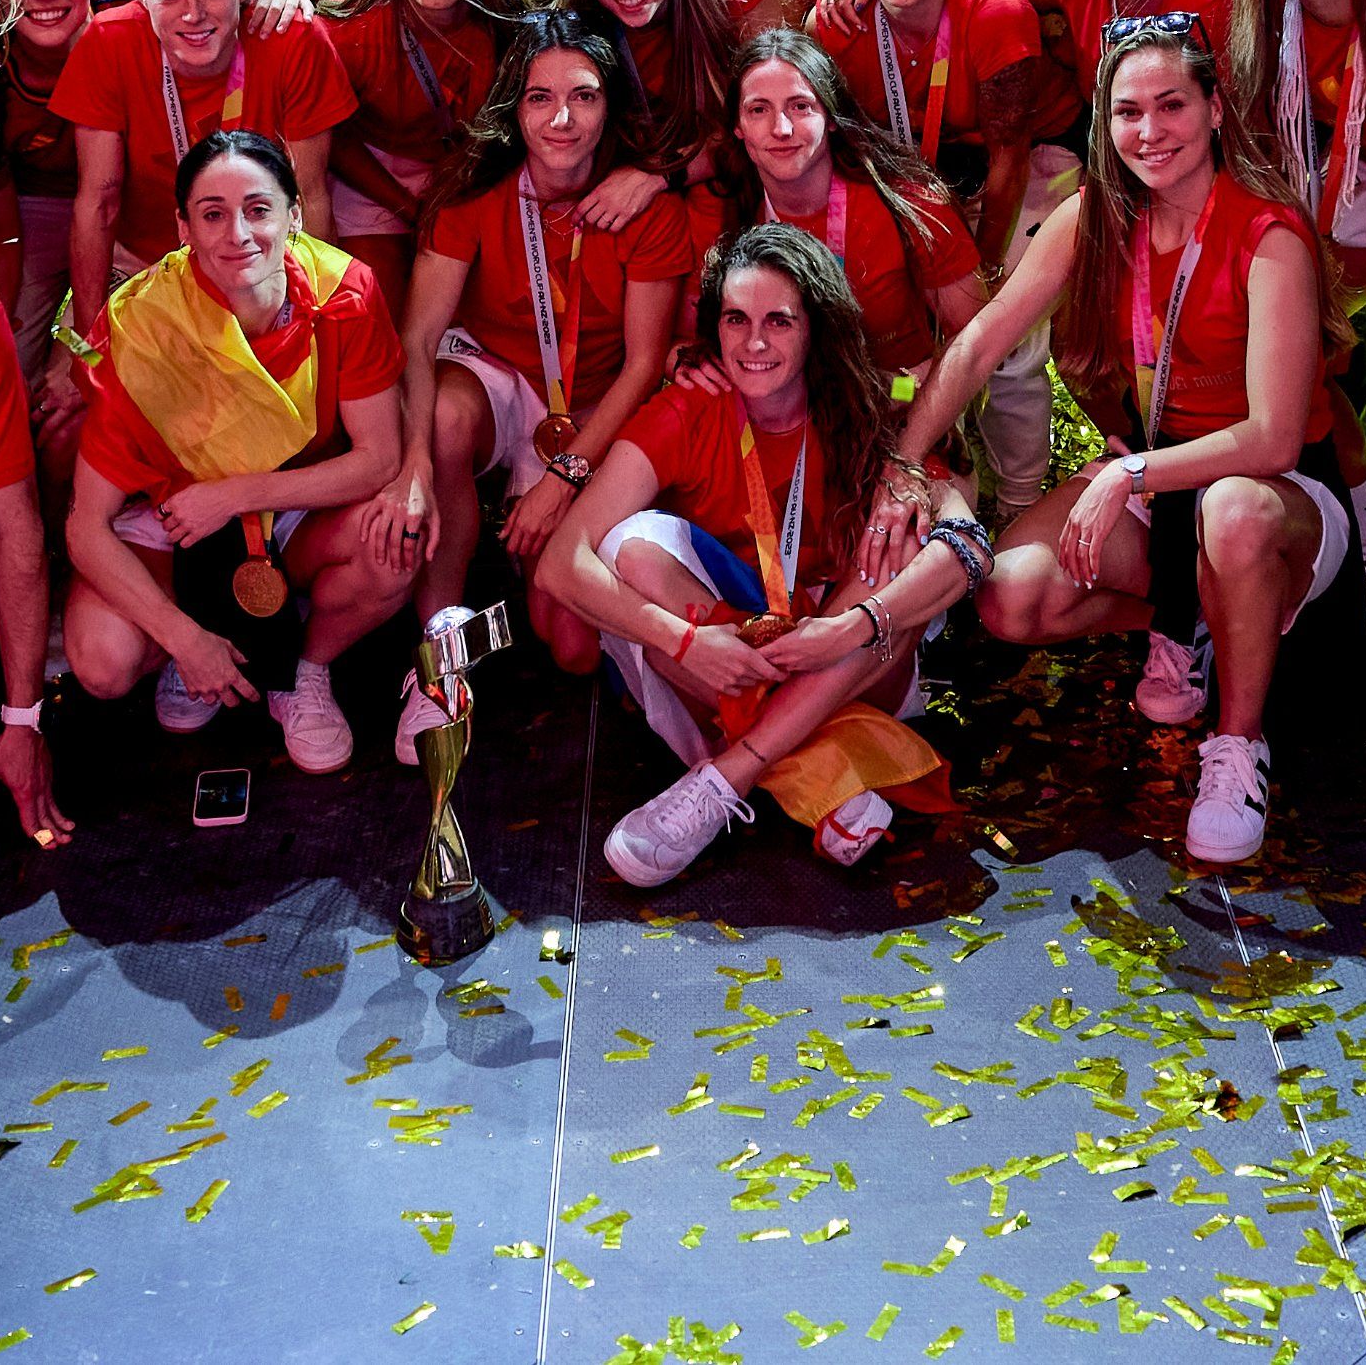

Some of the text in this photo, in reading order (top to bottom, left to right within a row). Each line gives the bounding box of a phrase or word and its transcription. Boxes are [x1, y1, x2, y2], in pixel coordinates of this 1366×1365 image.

[885, 50, 896, 80] WORLD
[890, 81, 898, 97] CUP
[530, 243, 541, 273] WORLD
[534, 274, 544, 291] CUP
[1159, 356, 1172, 387] WORLD
